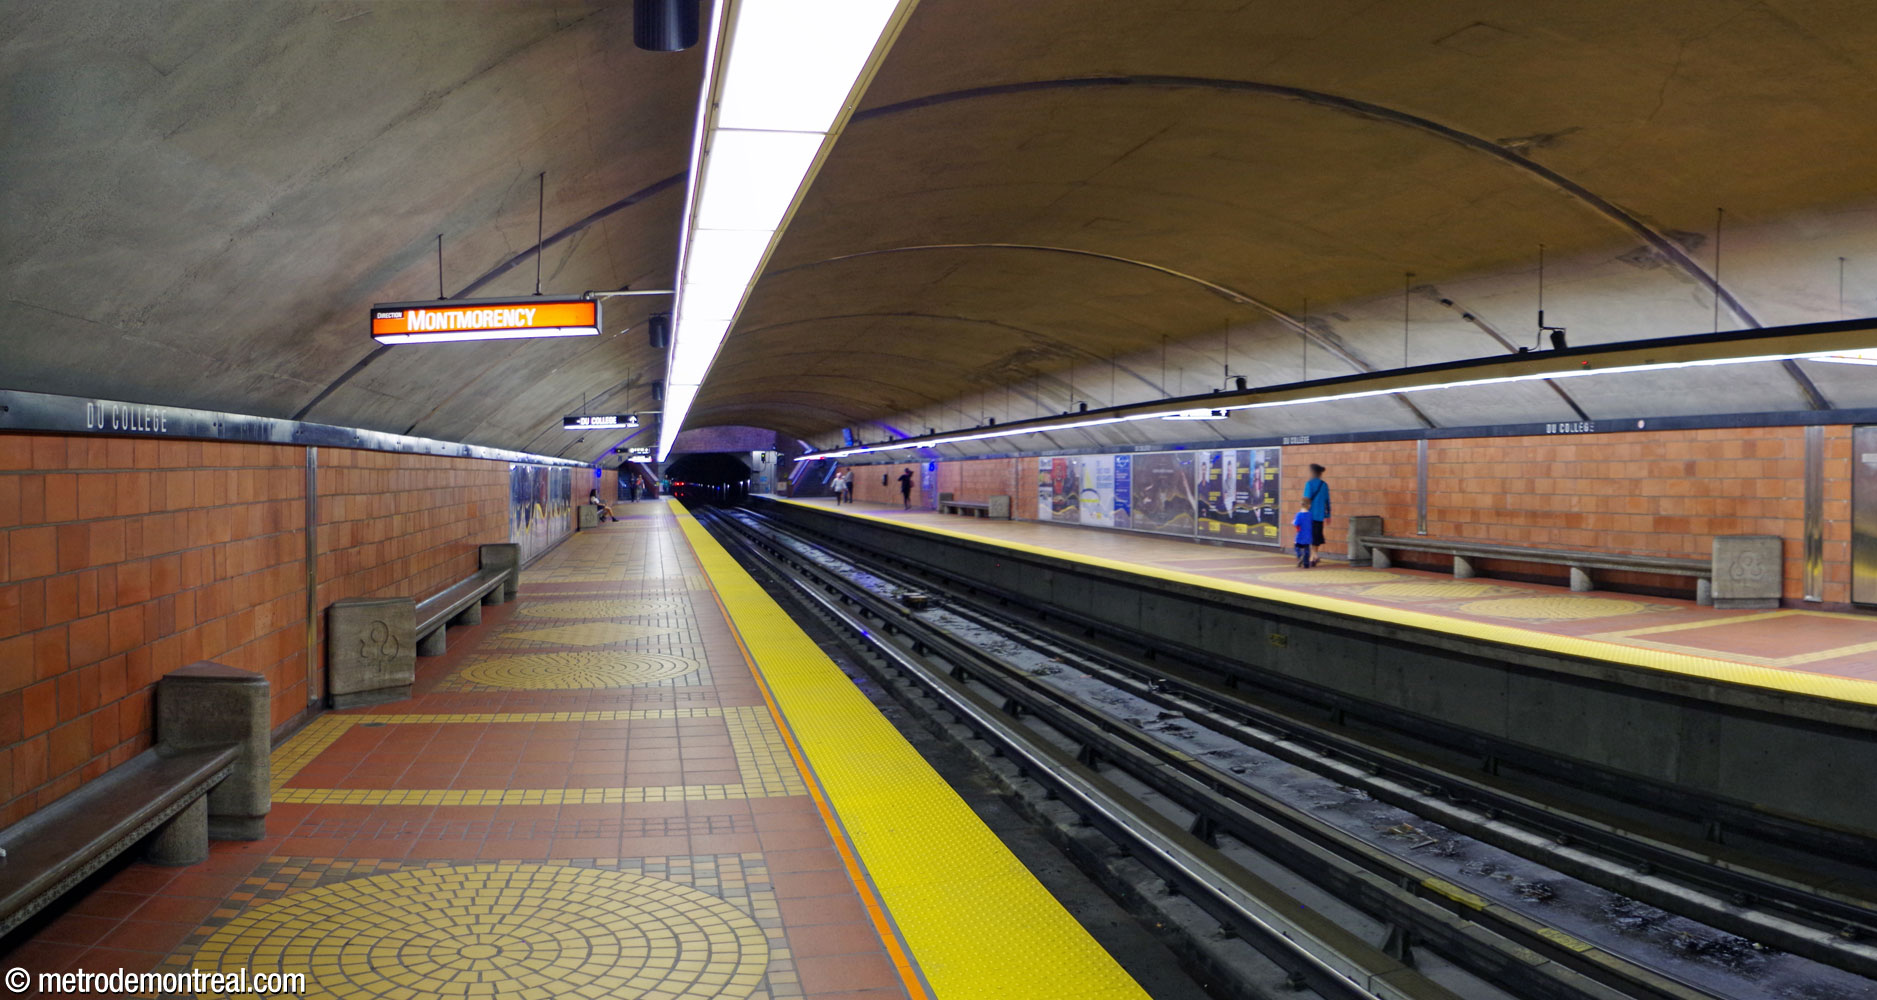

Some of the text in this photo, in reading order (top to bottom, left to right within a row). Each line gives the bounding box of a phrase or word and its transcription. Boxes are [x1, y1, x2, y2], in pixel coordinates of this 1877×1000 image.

[407, 308, 537, 331] MONTMORENCY
[87, 402, 167, 432] DU COLLÈGE
[1546, 423, 1557, 434] DU
